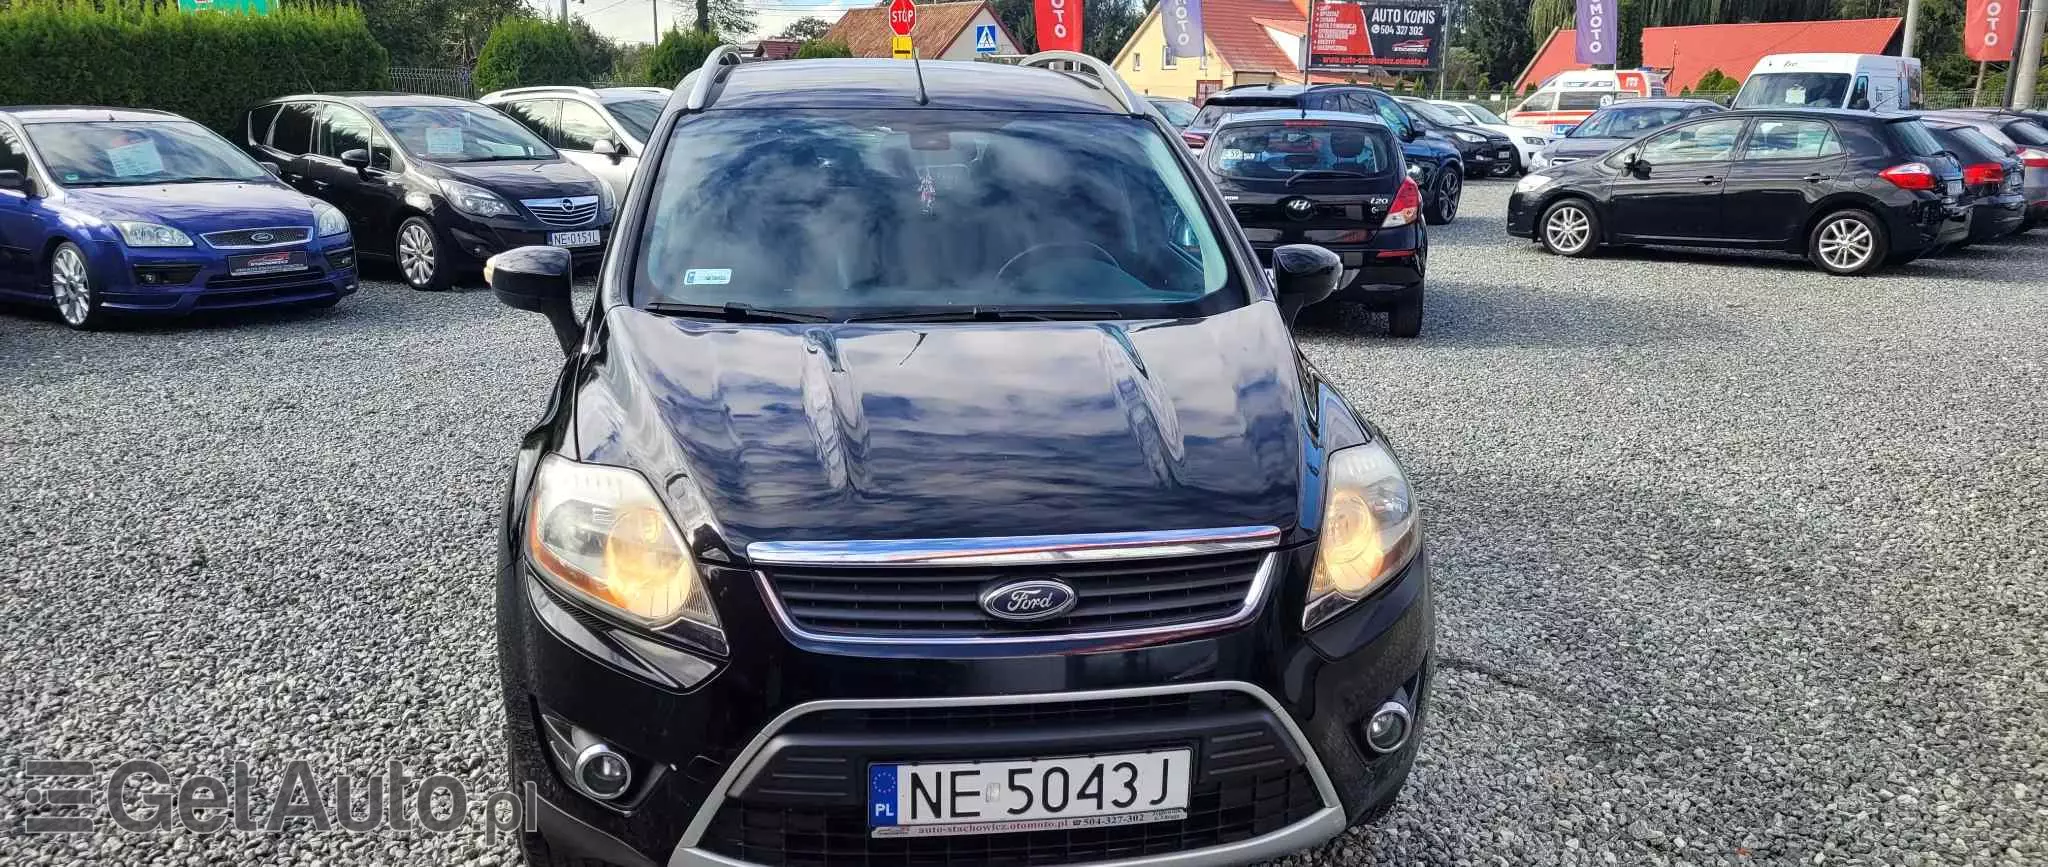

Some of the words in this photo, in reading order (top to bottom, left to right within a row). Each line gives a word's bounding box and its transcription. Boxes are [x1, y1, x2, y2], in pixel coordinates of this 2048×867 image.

[892, 10, 914, 22] STOP
[1371, 8, 1400, 23] AUTO
[1404, 9, 1436, 24] KOMIS
[1395, 26, 1408, 35] 327
[1409, 26, 1424, 36] 302
[554, 233, 568, 245] NE
[1007, 588, 1054, 612] Ford
[910, 769, 981, 820] NE
[1006, 758, 1169, 815] 5043J
[875, 803, 895, 817] PL
[918, 818, 1069, 835] auto-stachowicz.otomoto.pl
[1083, 813, 1145, 827] 504-327-302
